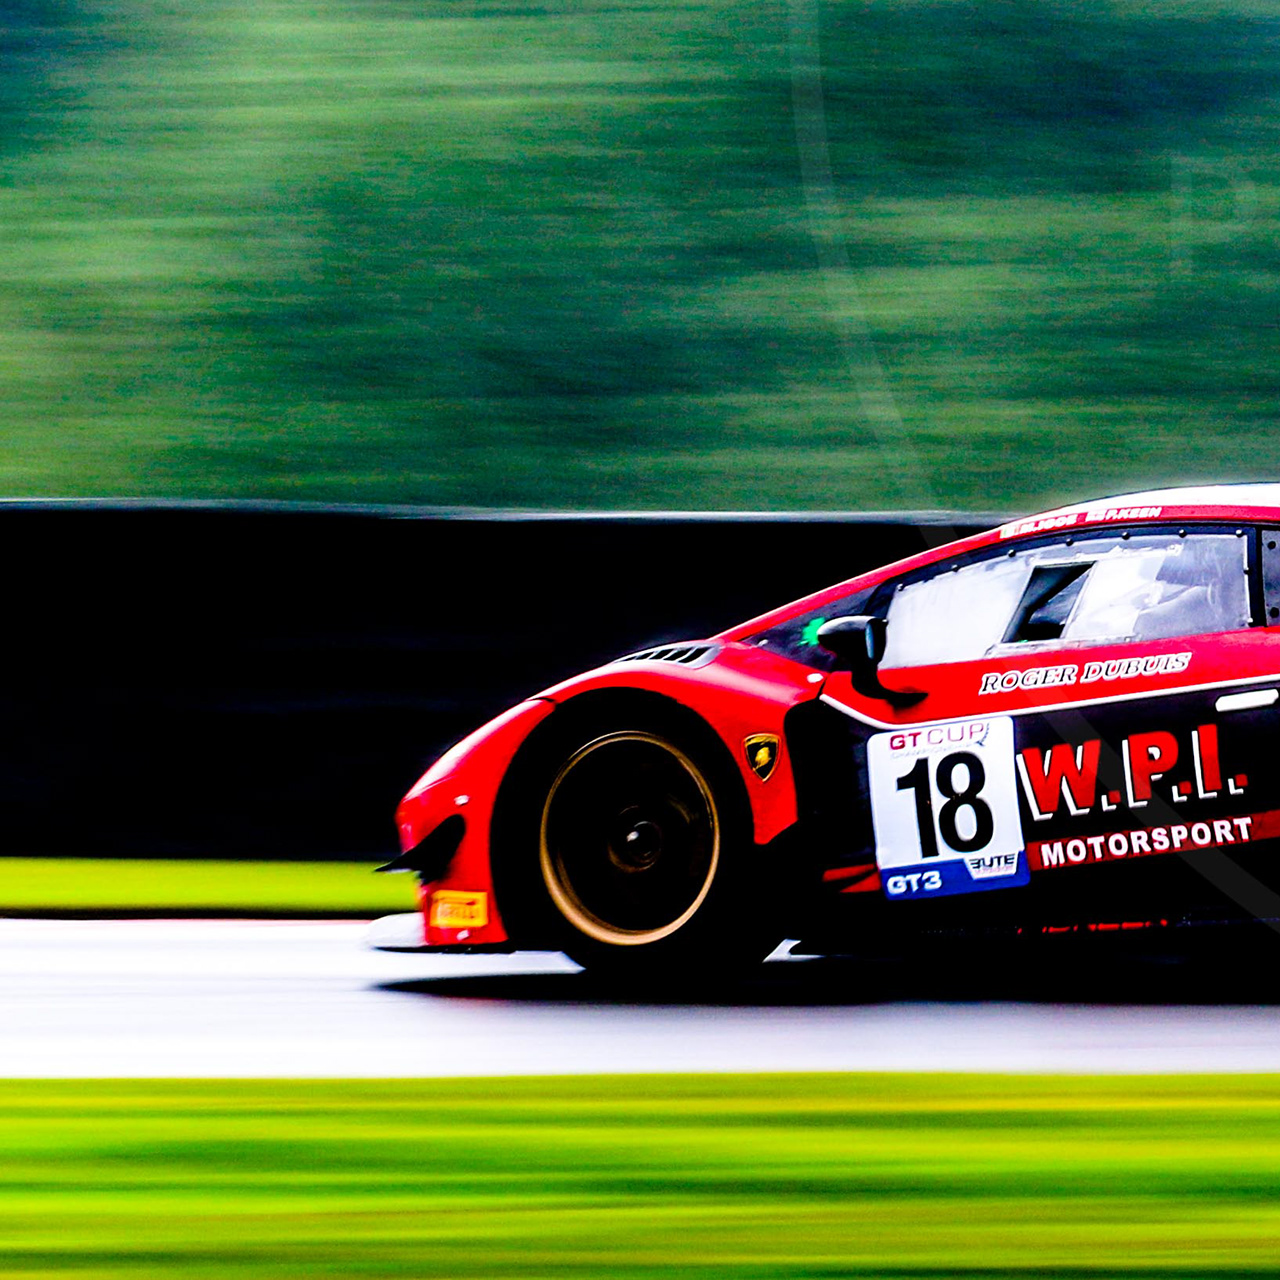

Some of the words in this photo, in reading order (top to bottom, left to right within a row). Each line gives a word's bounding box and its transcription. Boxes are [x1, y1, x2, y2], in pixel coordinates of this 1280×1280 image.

[980, 666, 1078, 694] ROGER
[1081, 653, 1192, 683] DUBUIS
[1016, 723, 1249, 821] W.P.I.
[896, 751, 995, 859] 18
[1040, 816, 1253, 867] MOTORSPORT
[886, 870, 943, 895] GT3
